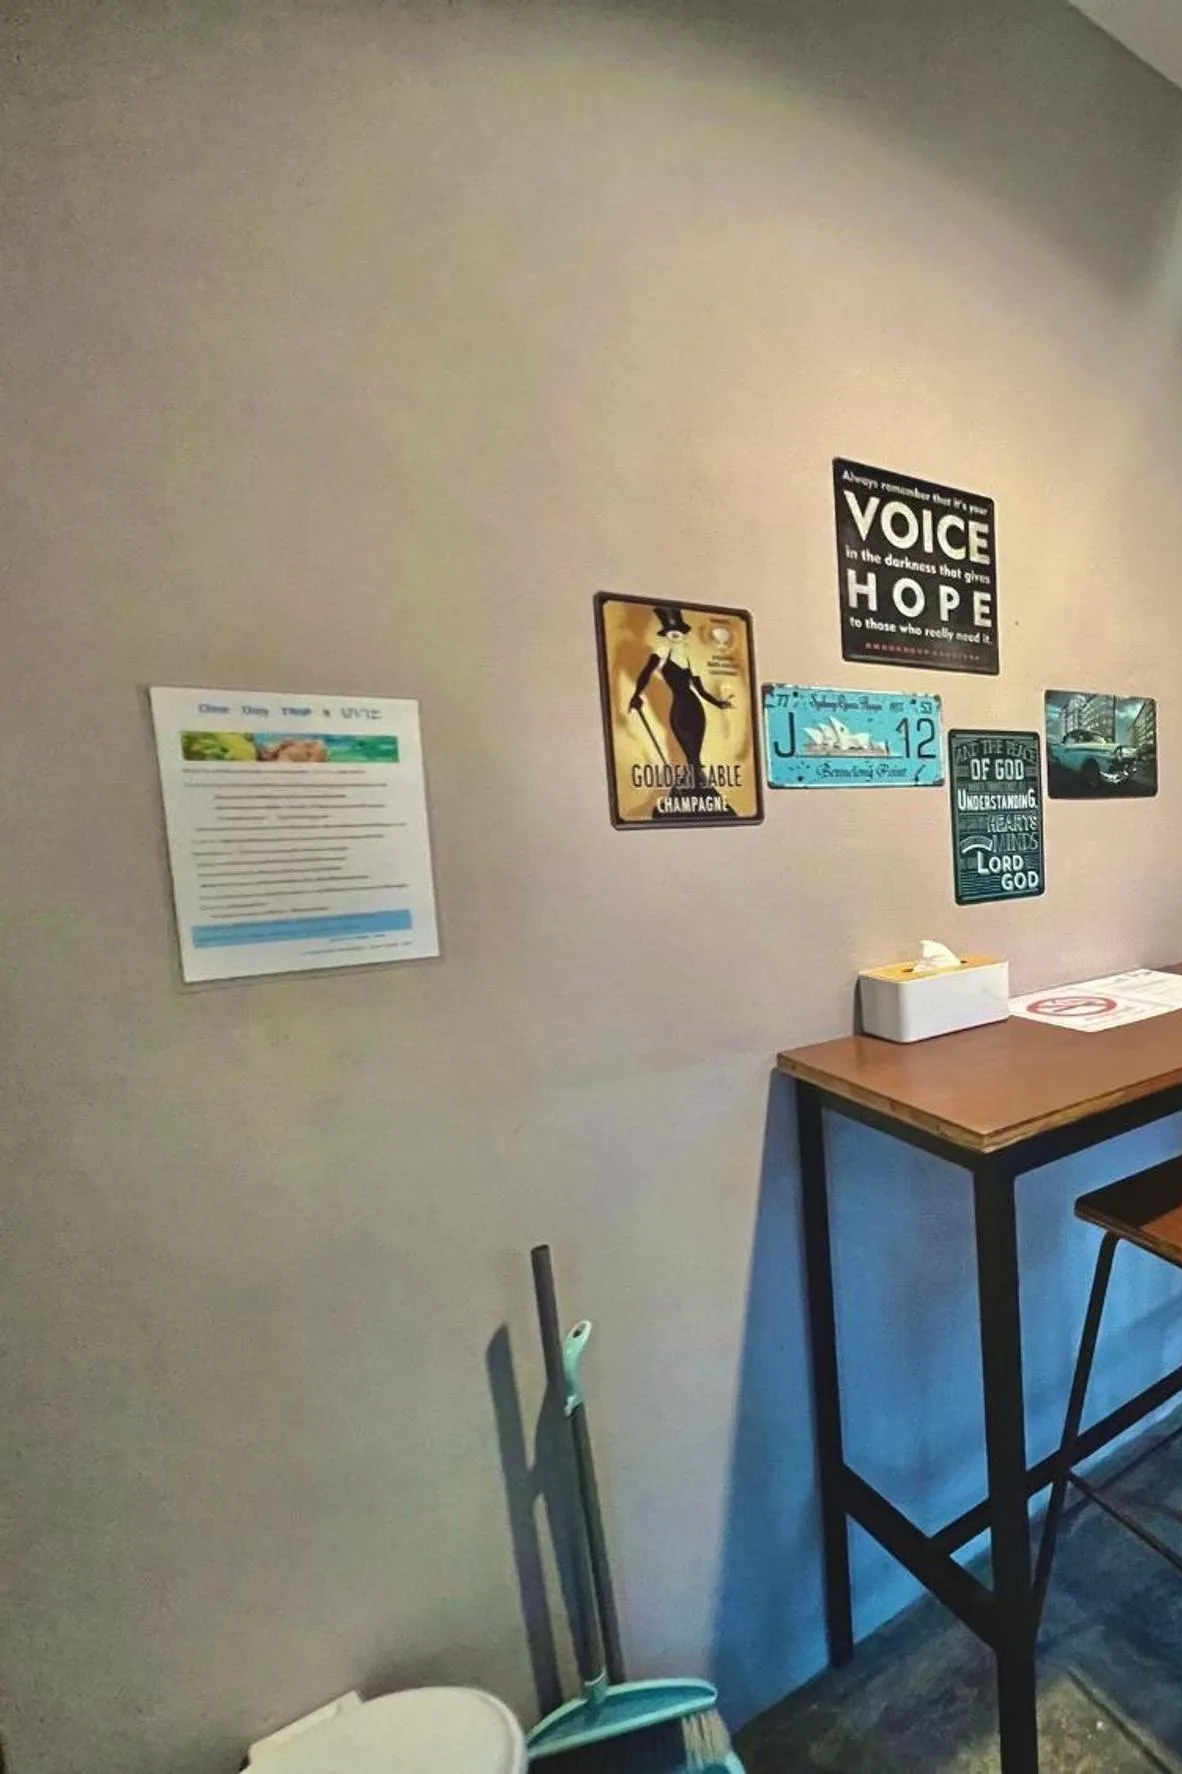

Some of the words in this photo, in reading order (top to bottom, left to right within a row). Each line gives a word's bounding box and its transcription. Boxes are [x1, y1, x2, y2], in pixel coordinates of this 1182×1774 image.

[843, 470, 878, 489] Always
[881, 482, 930, 500] remember
[932, 493, 951, 506] that
[969, 504, 988, 516] your
[844, 490, 990, 565] VOICE
[846, 544, 858, 559] in
[861, 547, 882, 564] the
[884, 554, 937, 575] darkness
[939, 564, 962, 579] that
[964, 570, 990, 584] gives
[849, 616, 863, 629] to
[865, 618, 897, 633] those
[899, 622, 922, 636] who
[925, 627, 953, 643] really
[956, 630, 981, 643] need
[773, 712, 796, 758] J
[895, 718, 937, 759] 12
[631, 764, 695, 788] GOLDEN
[970, 758, 990, 780] OF
[995, 758, 1025, 780] GOD
[657, 795, 729, 813] CHAMPAGNE
[977, 850, 1024, 874] LORD
[1001, 871, 1039, 891] GOD
